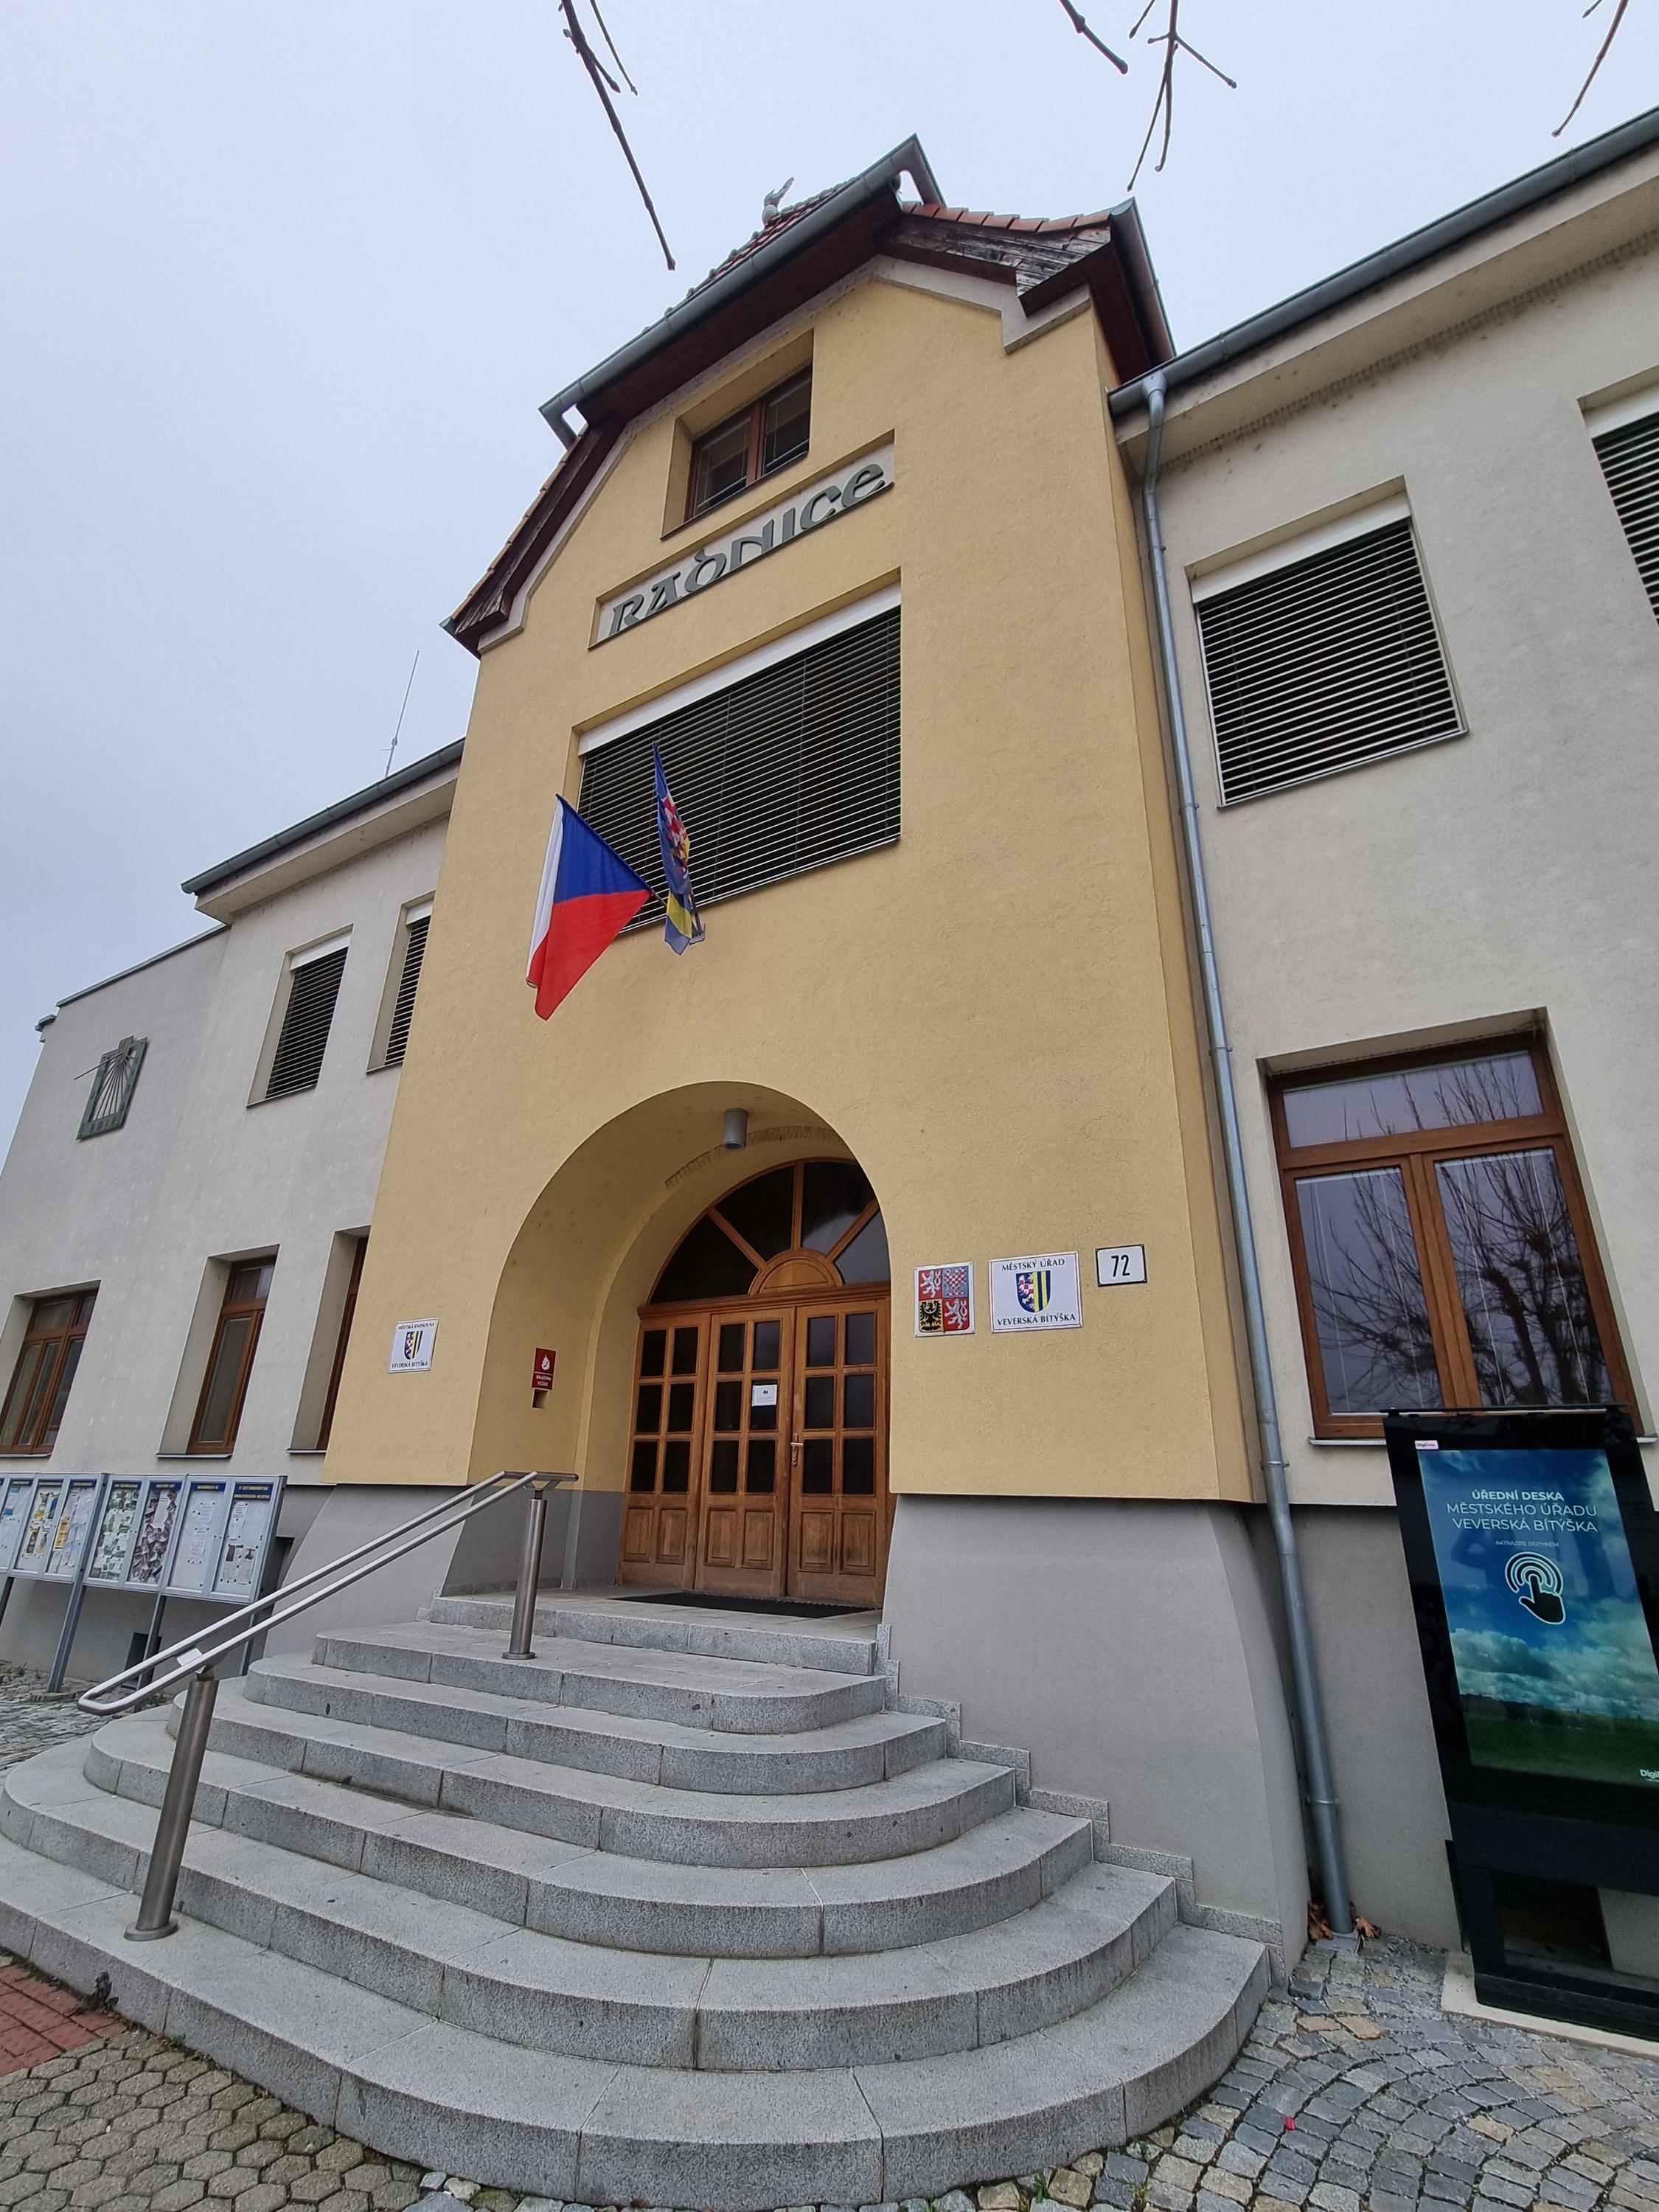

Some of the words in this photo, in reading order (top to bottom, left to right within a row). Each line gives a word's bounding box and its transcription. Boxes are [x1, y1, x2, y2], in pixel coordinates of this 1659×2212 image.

[1040, 1258, 1065, 1267] ÚŘAD
[1110, 1254, 1130, 1277] 72
[997, 1314, 1038, 1326] VEVERSKÁ
[1040, 1312, 1076, 1323] BÍTÝŠKA
[1472, 1489, 1519, 1500] ÚŘEDNÍ
[1522, 1492, 1565, 1501] DESKA
[1447, 1501, 1537, 1515] MĚSTSKÉHO
[1540, 1503, 1597, 1517] ÚŘADU
[1452, 1517, 1531, 1531] VEVERSKÁ
[1534, 1519, 1598, 1533] BÍTÝŠKA
